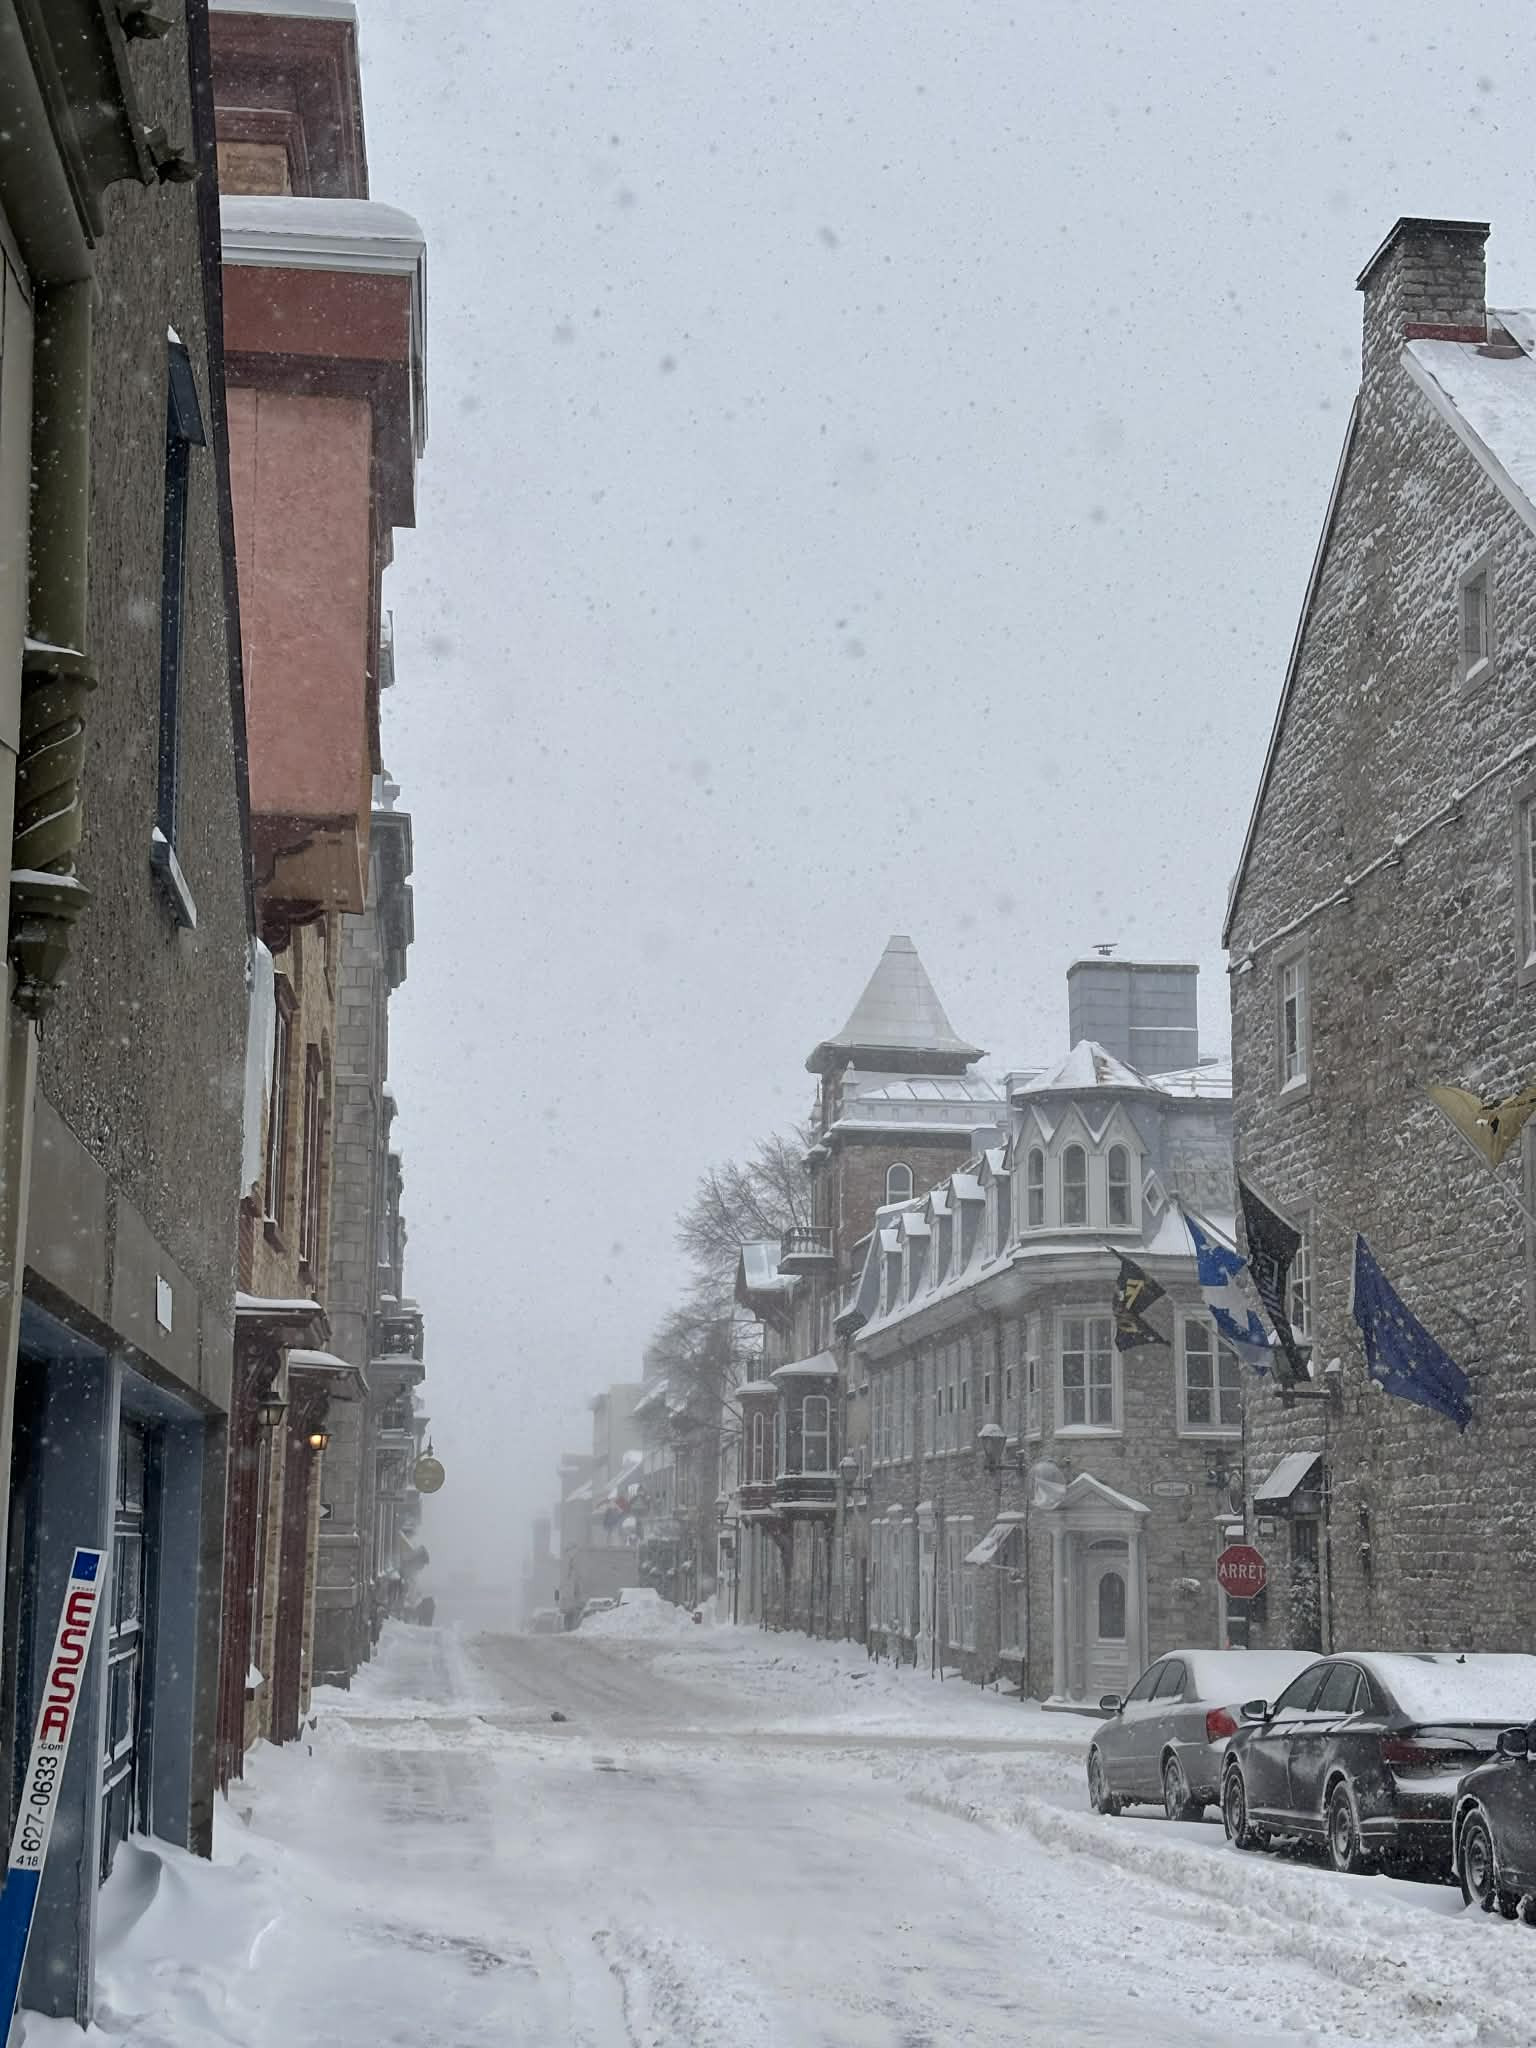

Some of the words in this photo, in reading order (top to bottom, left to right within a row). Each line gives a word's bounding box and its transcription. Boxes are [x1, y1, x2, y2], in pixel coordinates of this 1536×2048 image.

[1219, 1563, 1265, 1580] ARRÊT
[40, 1591, 96, 1743] ESSA
[21, 1756, 58, 1852] 627-0633
